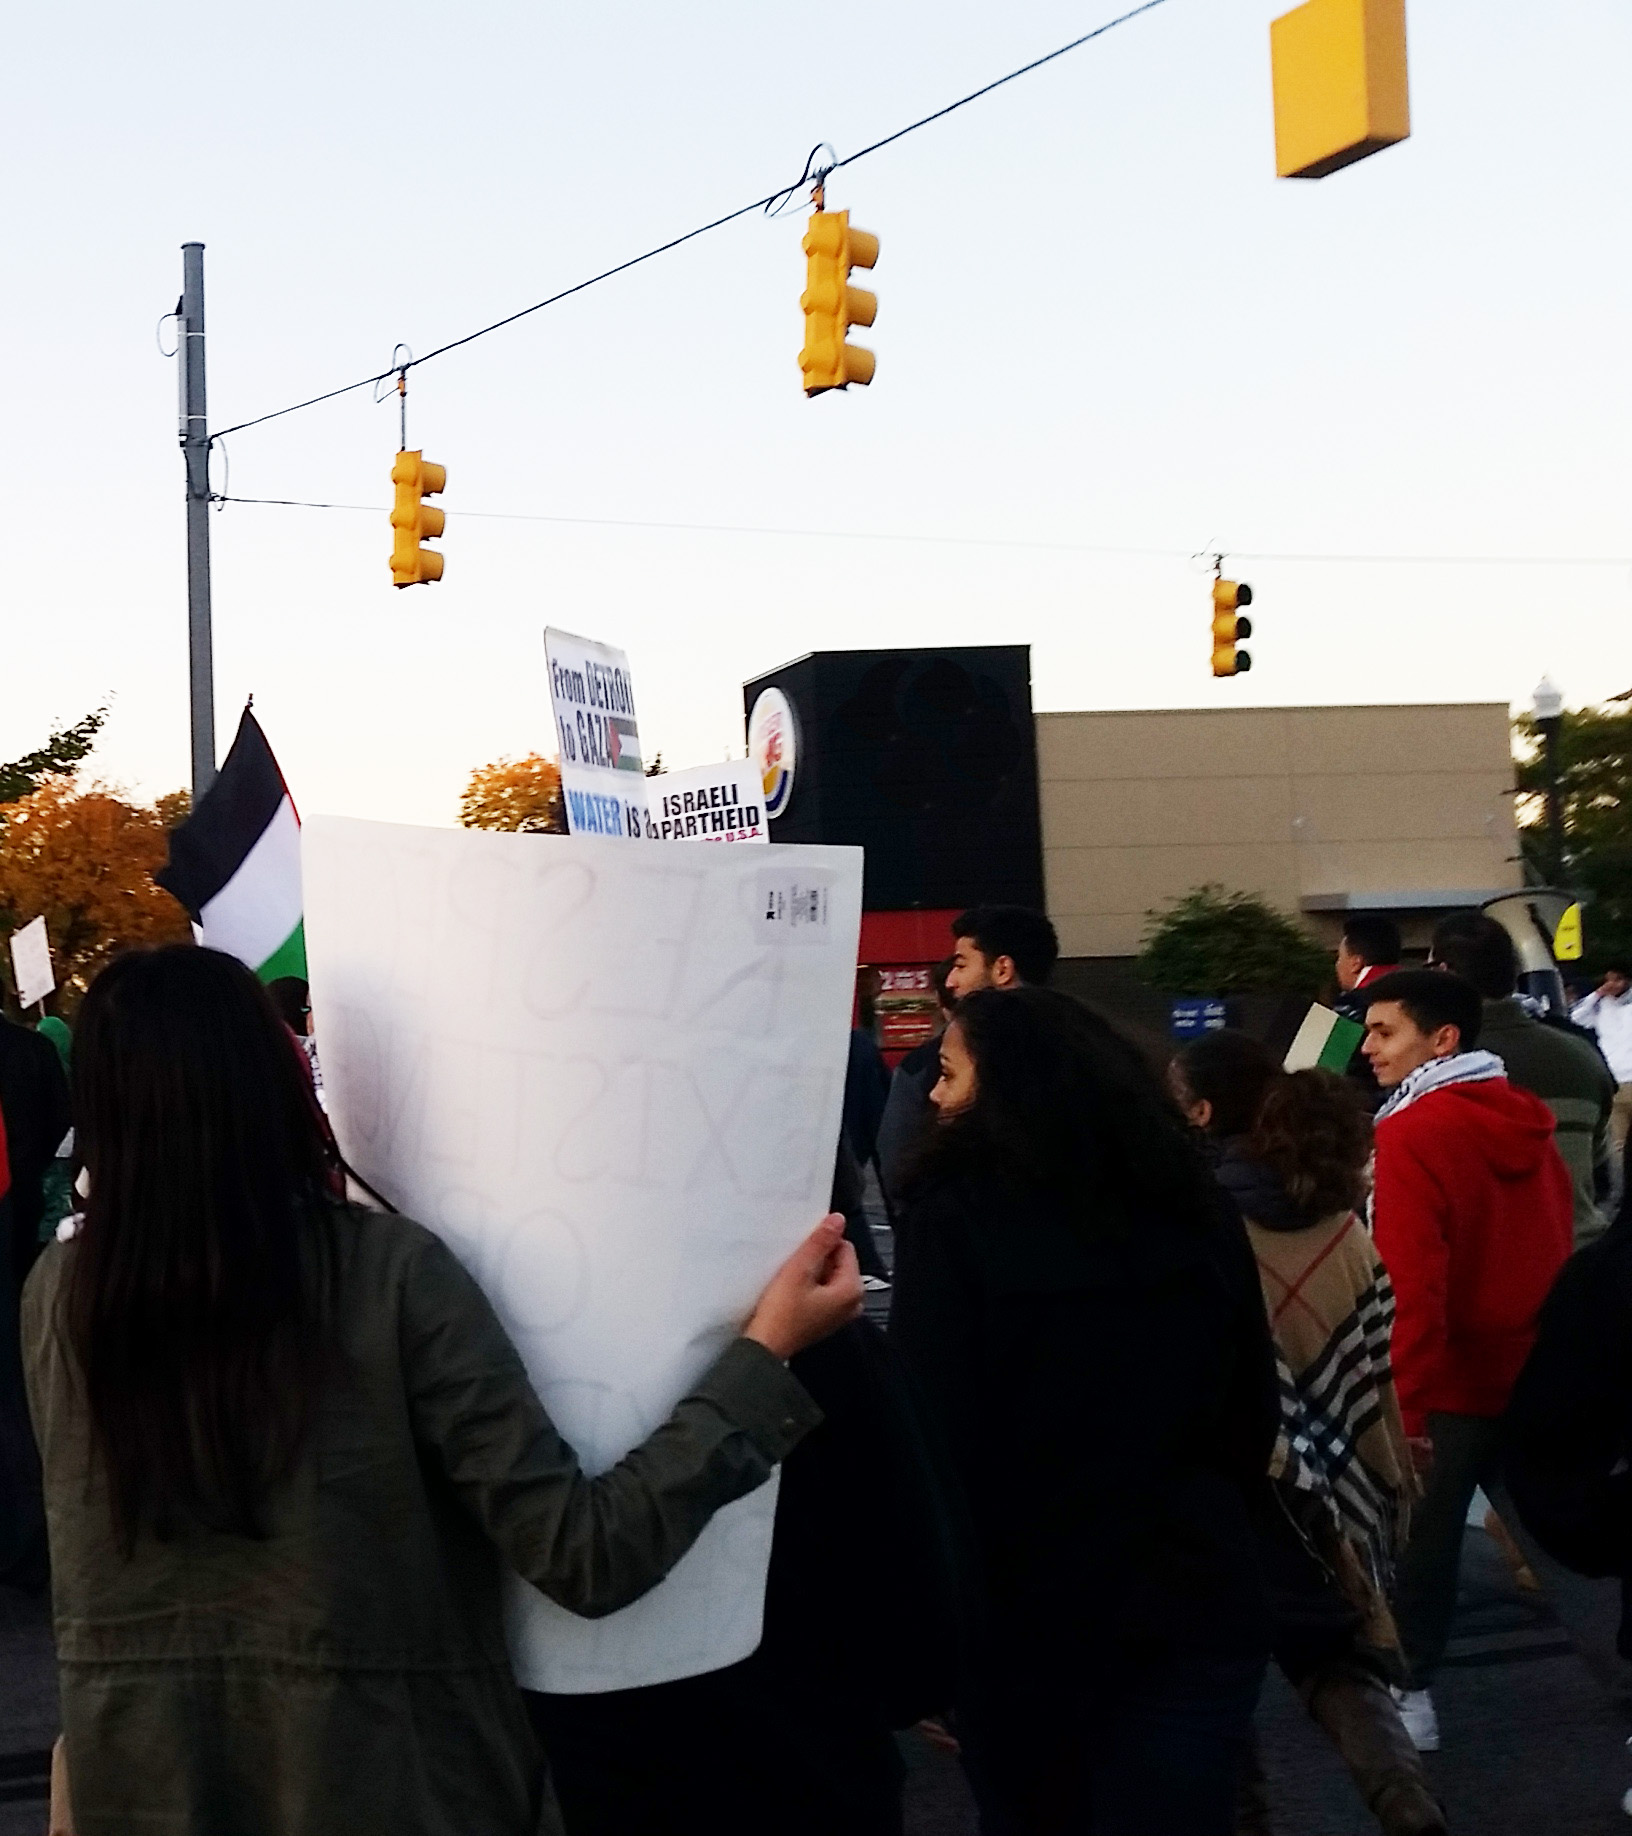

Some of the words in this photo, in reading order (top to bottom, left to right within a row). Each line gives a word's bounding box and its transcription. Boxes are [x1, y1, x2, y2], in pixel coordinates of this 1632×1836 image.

[552, 658, 586, 704] From
[559, 715, 576, 762] to
[576, 710, 615, 768] GAZA
[568, 788, 623, 836] WATER
[624, 799, 641, 838] is
[663, 783, 739, 817] ISRAELI
